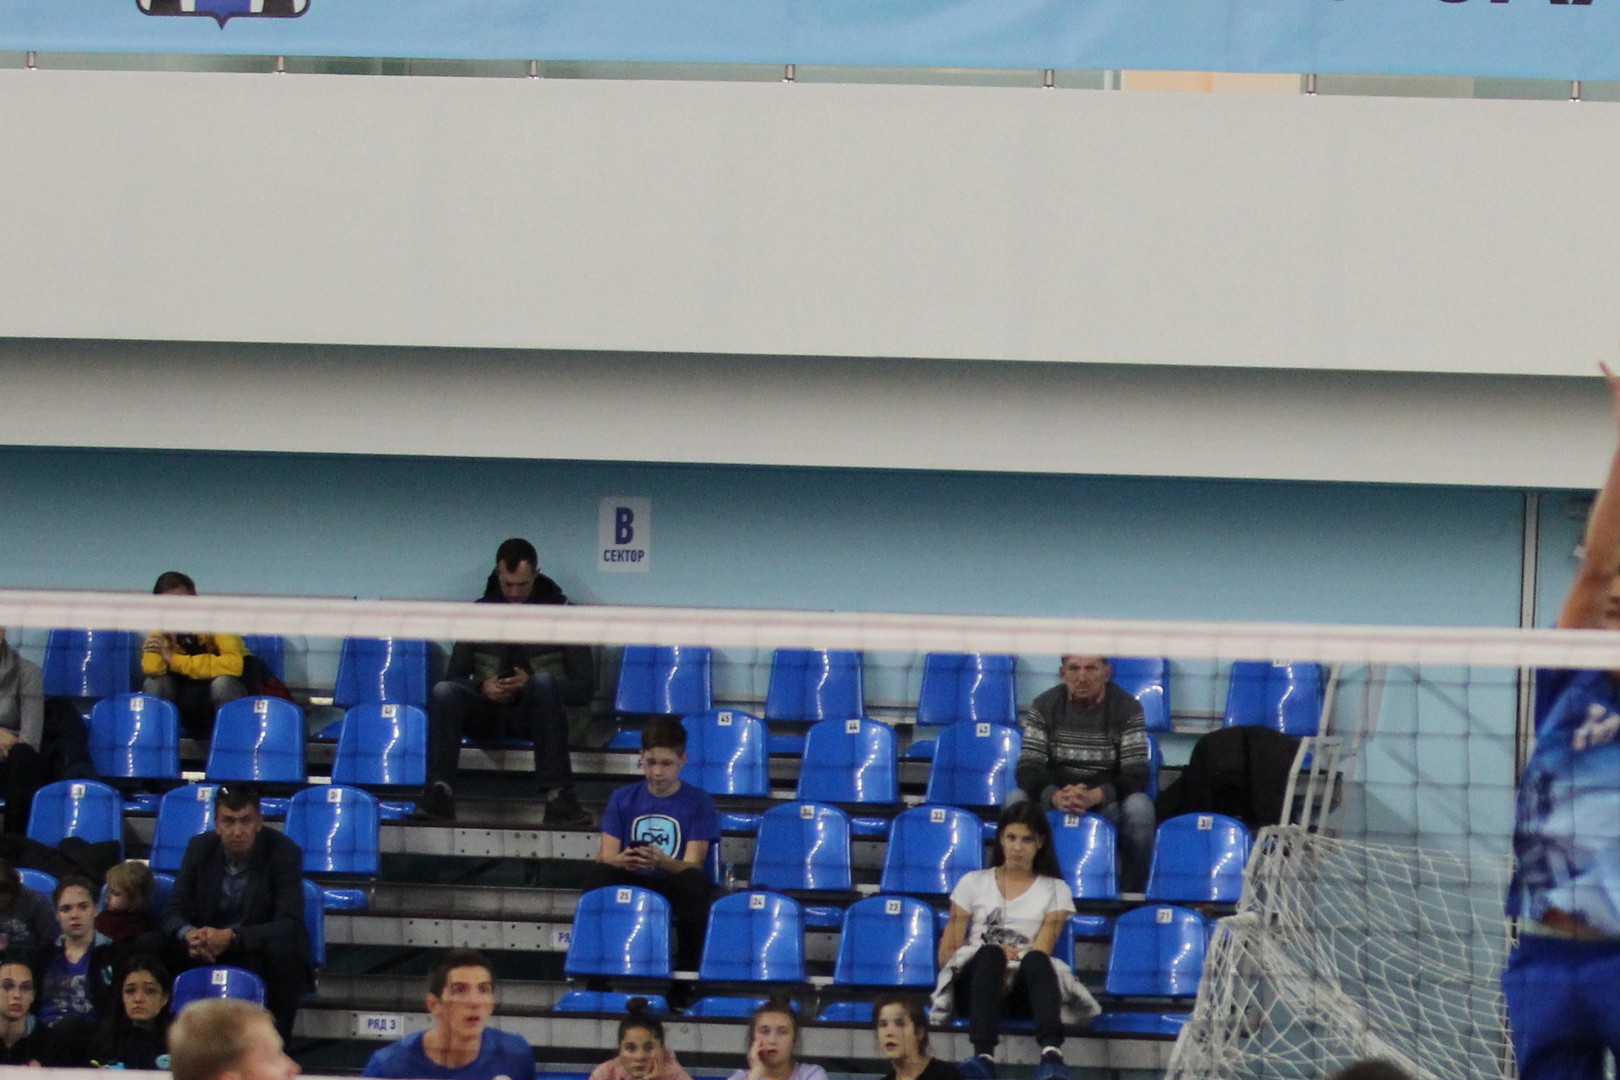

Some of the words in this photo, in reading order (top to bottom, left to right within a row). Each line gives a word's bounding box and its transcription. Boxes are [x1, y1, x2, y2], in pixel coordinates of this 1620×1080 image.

[615, 506, 635, 545] В
[603, 548, 646, 563] СЕКТОР
[367, 1018, 387, 1032] РЯД
[390, 1018, 396, 1030] 3
